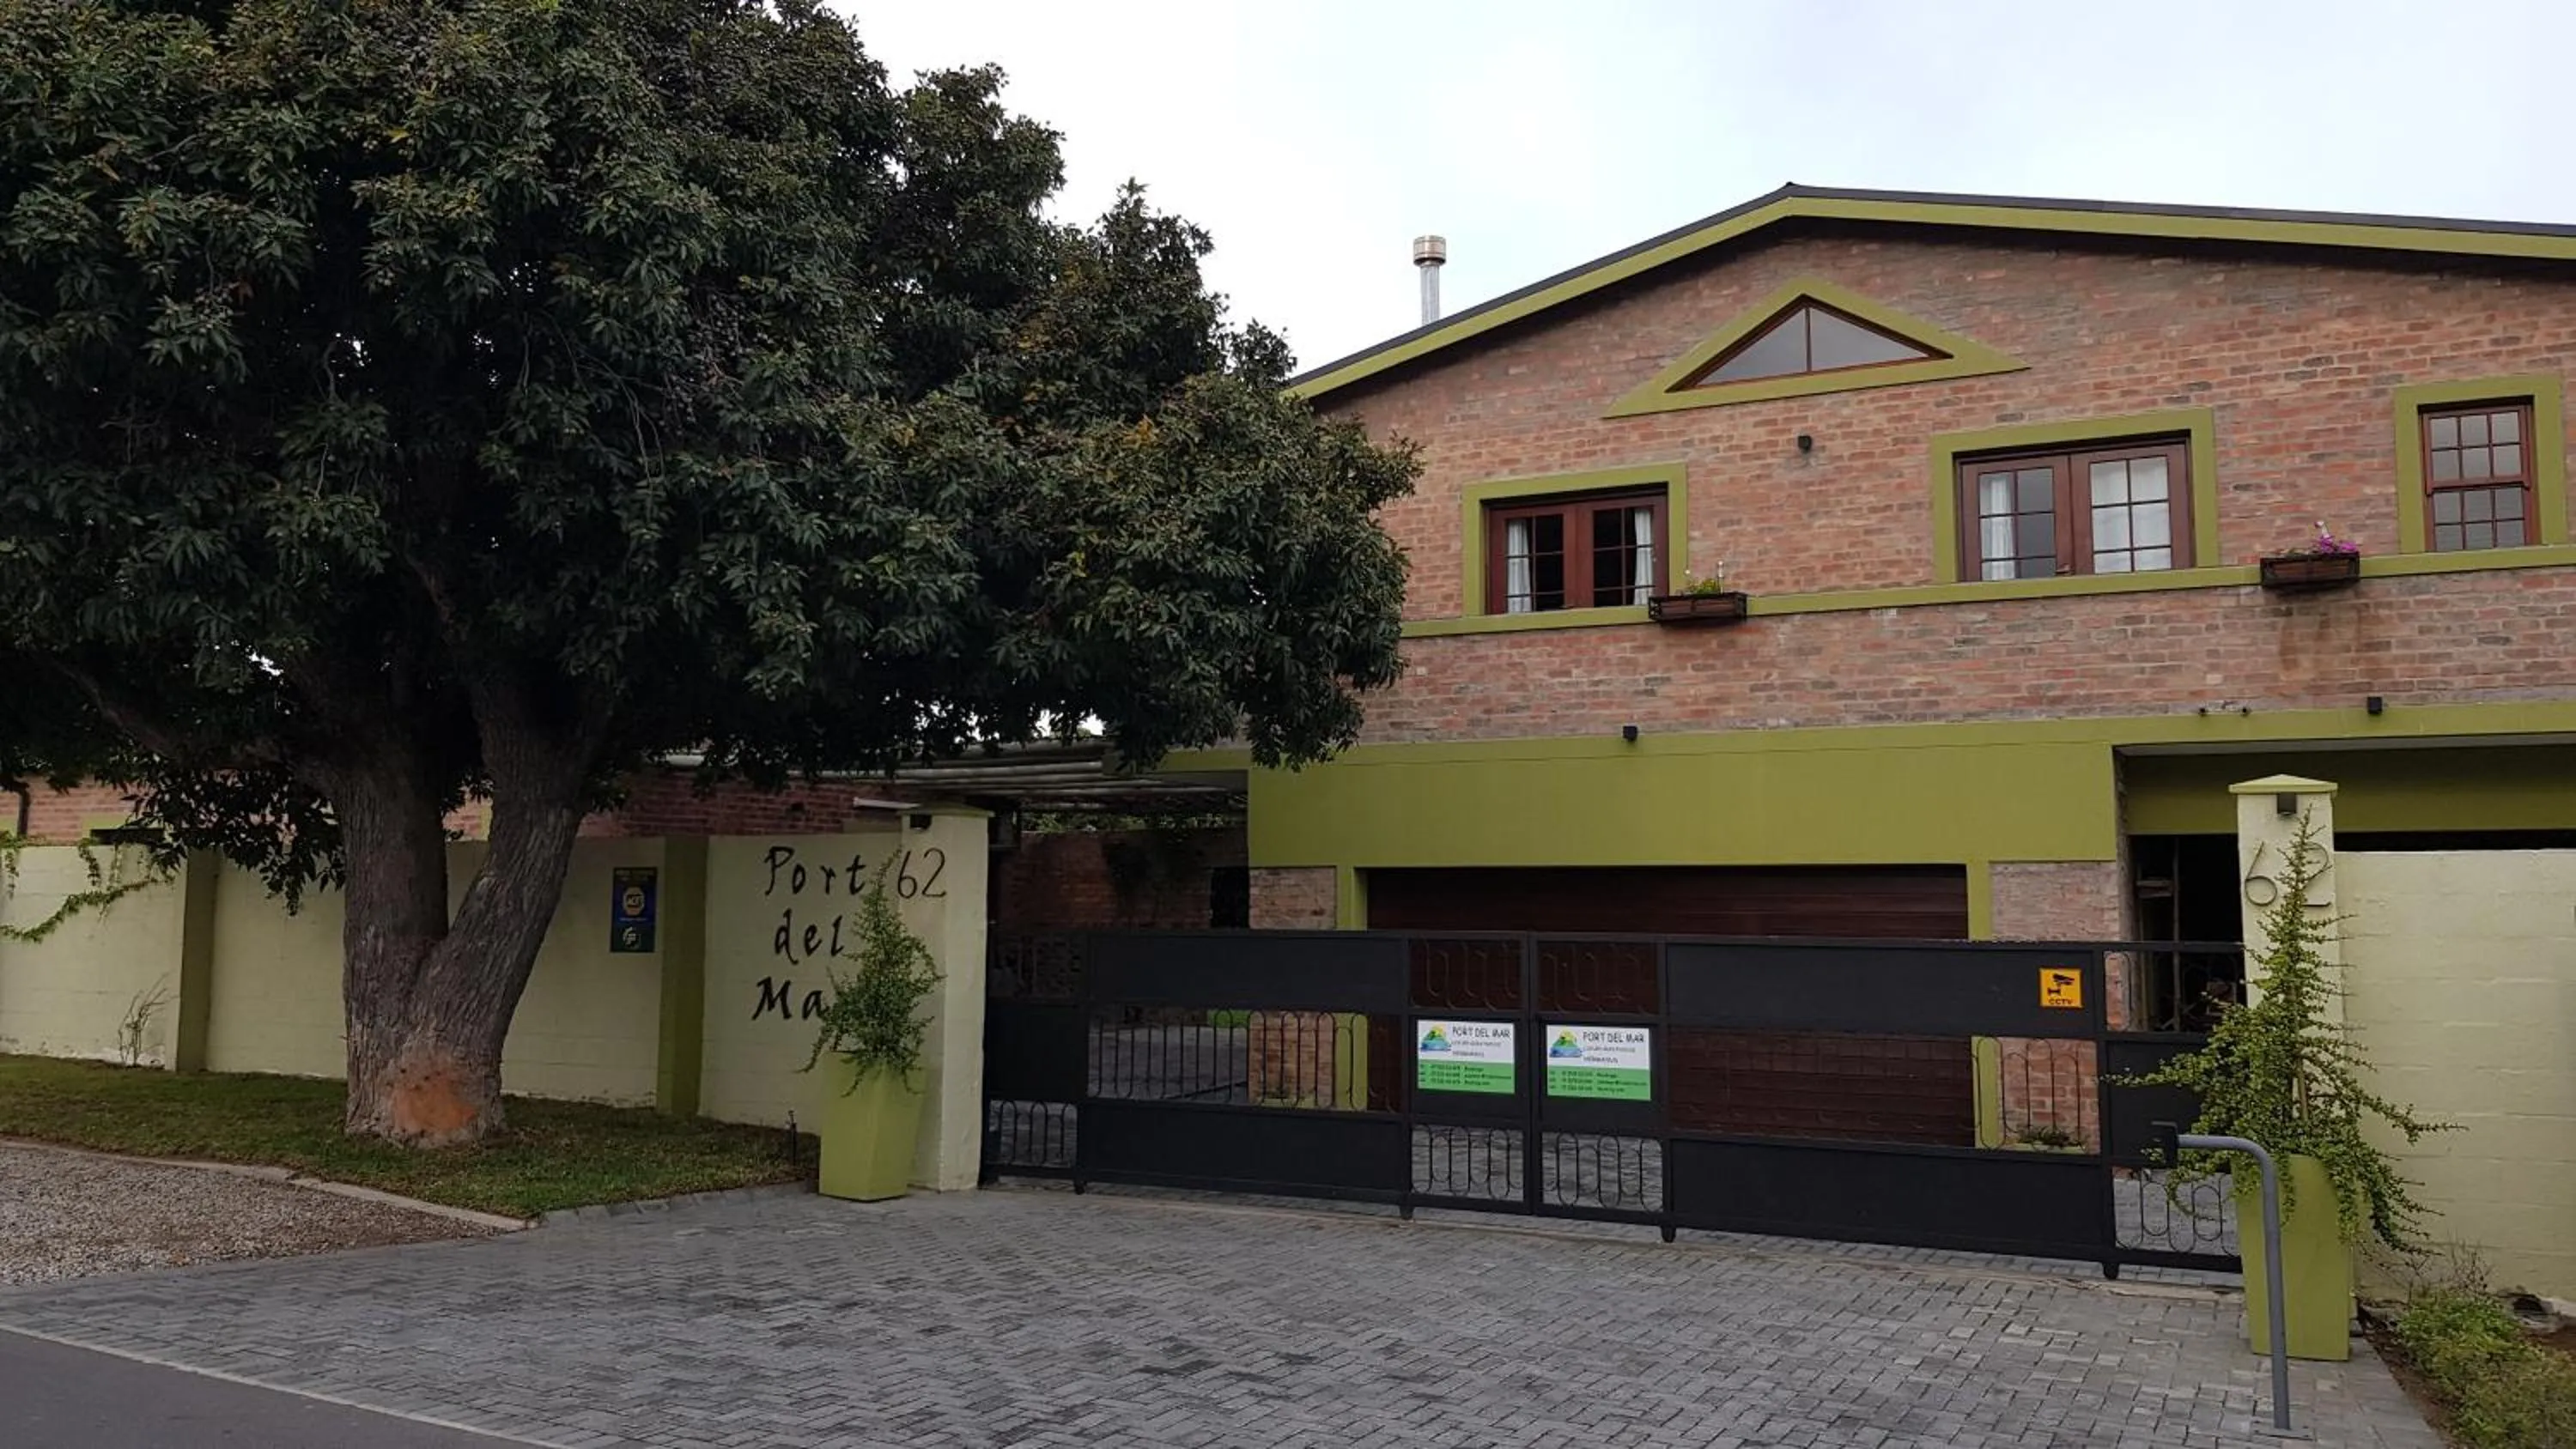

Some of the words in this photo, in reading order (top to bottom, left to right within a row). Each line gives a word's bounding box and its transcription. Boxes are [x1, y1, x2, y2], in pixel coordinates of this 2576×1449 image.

[764, 846, 866, 896] Port
[897, 847, 947, 899] 62
[2245, 841, 2332, 907] 62
[775, 908, 845, 965] del
[751, 976, 835, 1021] Ma
[1452, 1026, 1473, 1036] PORT
[1475, 1028, 1490, 1038] DEL
[1492, 1028, 1511, 1038] MAR
[1583, 1031, 1606, 1041] PORT
[1607, 1033, 1623, 1043] DEL
[1625, 1034, 1644, 1043] MAR
